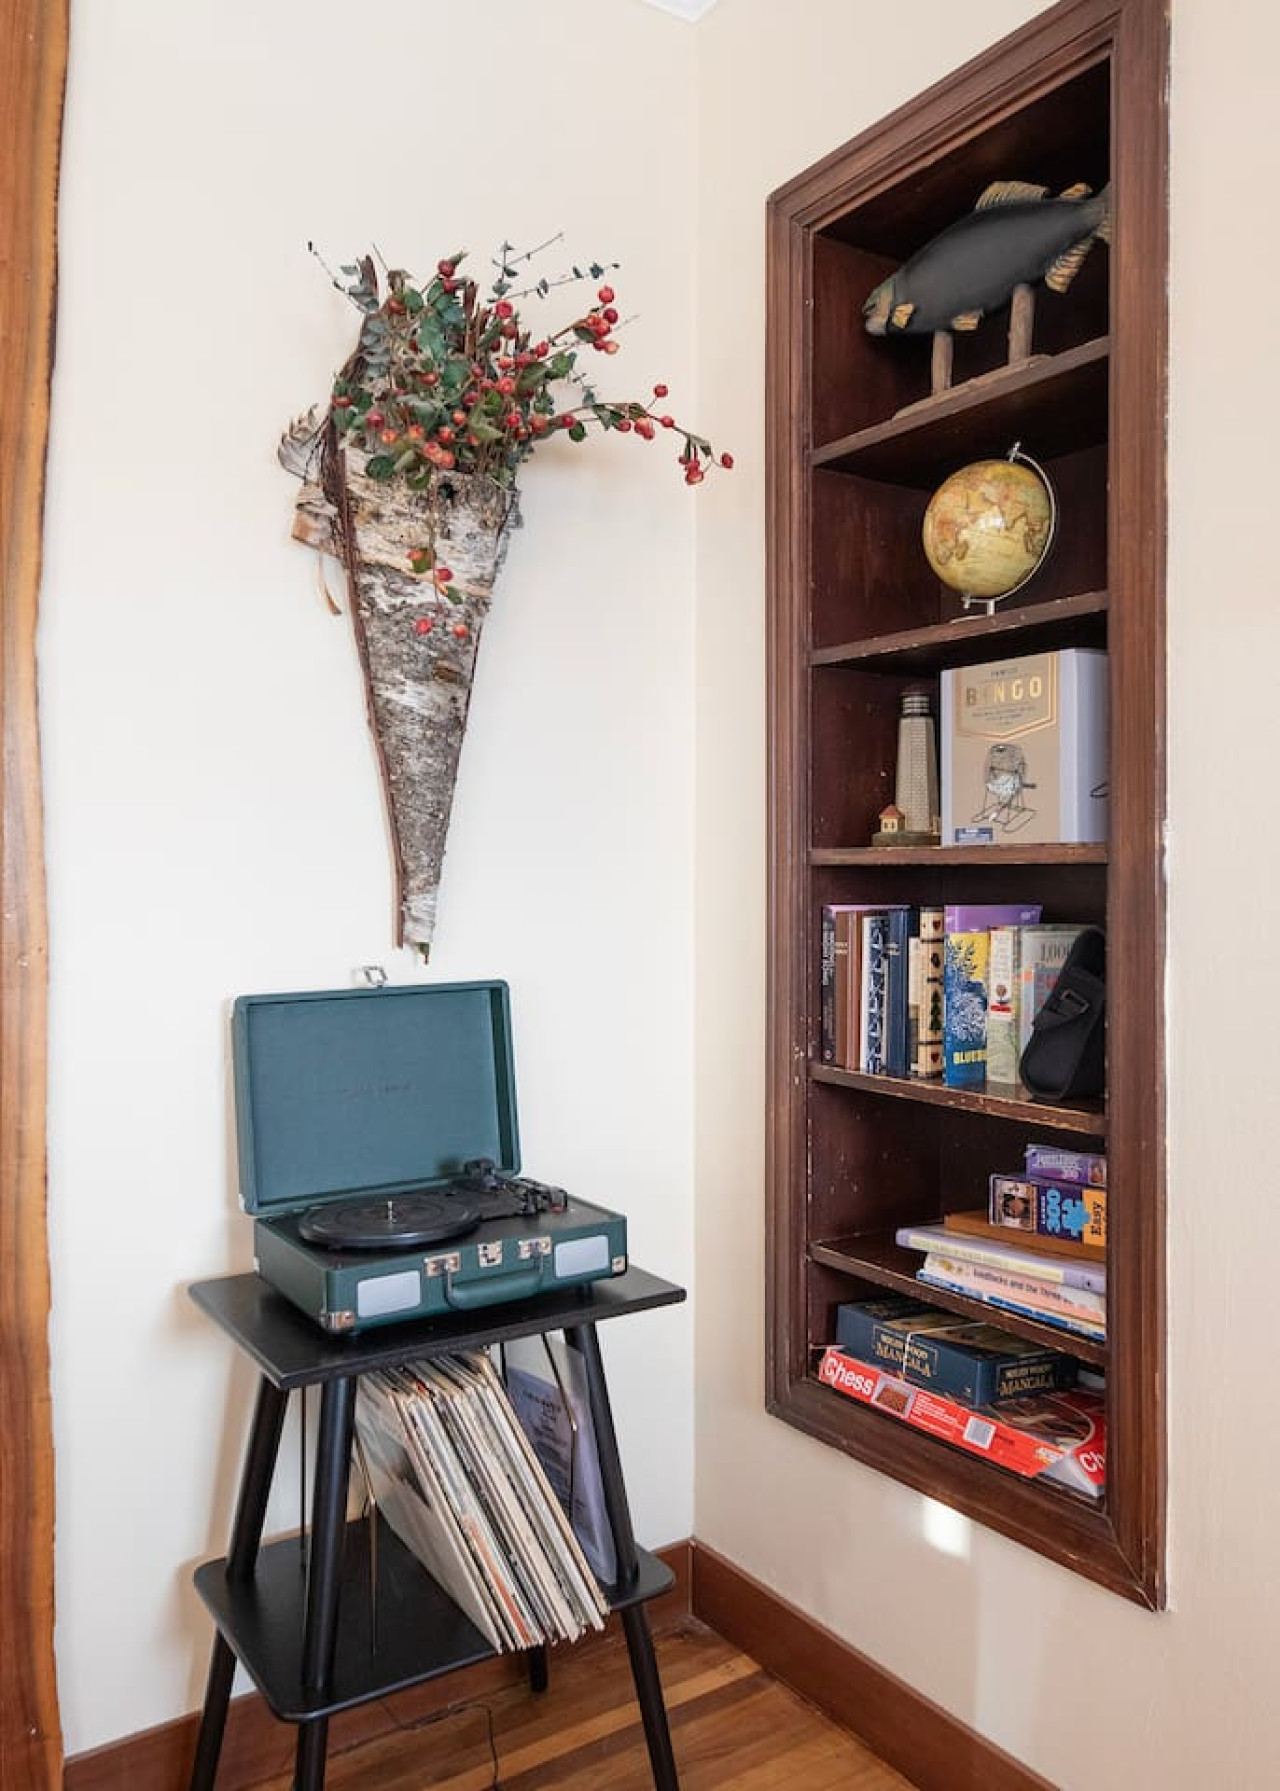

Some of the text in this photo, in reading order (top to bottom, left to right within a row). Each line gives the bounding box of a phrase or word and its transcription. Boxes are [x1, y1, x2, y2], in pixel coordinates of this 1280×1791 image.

[966, 676, 1042, 706] BINGO
[1046, 1189, 1061, 1234] 300
[1091, 1201, 1104, 1236] Easy
[823, 1357, 875, 1396] Chess
